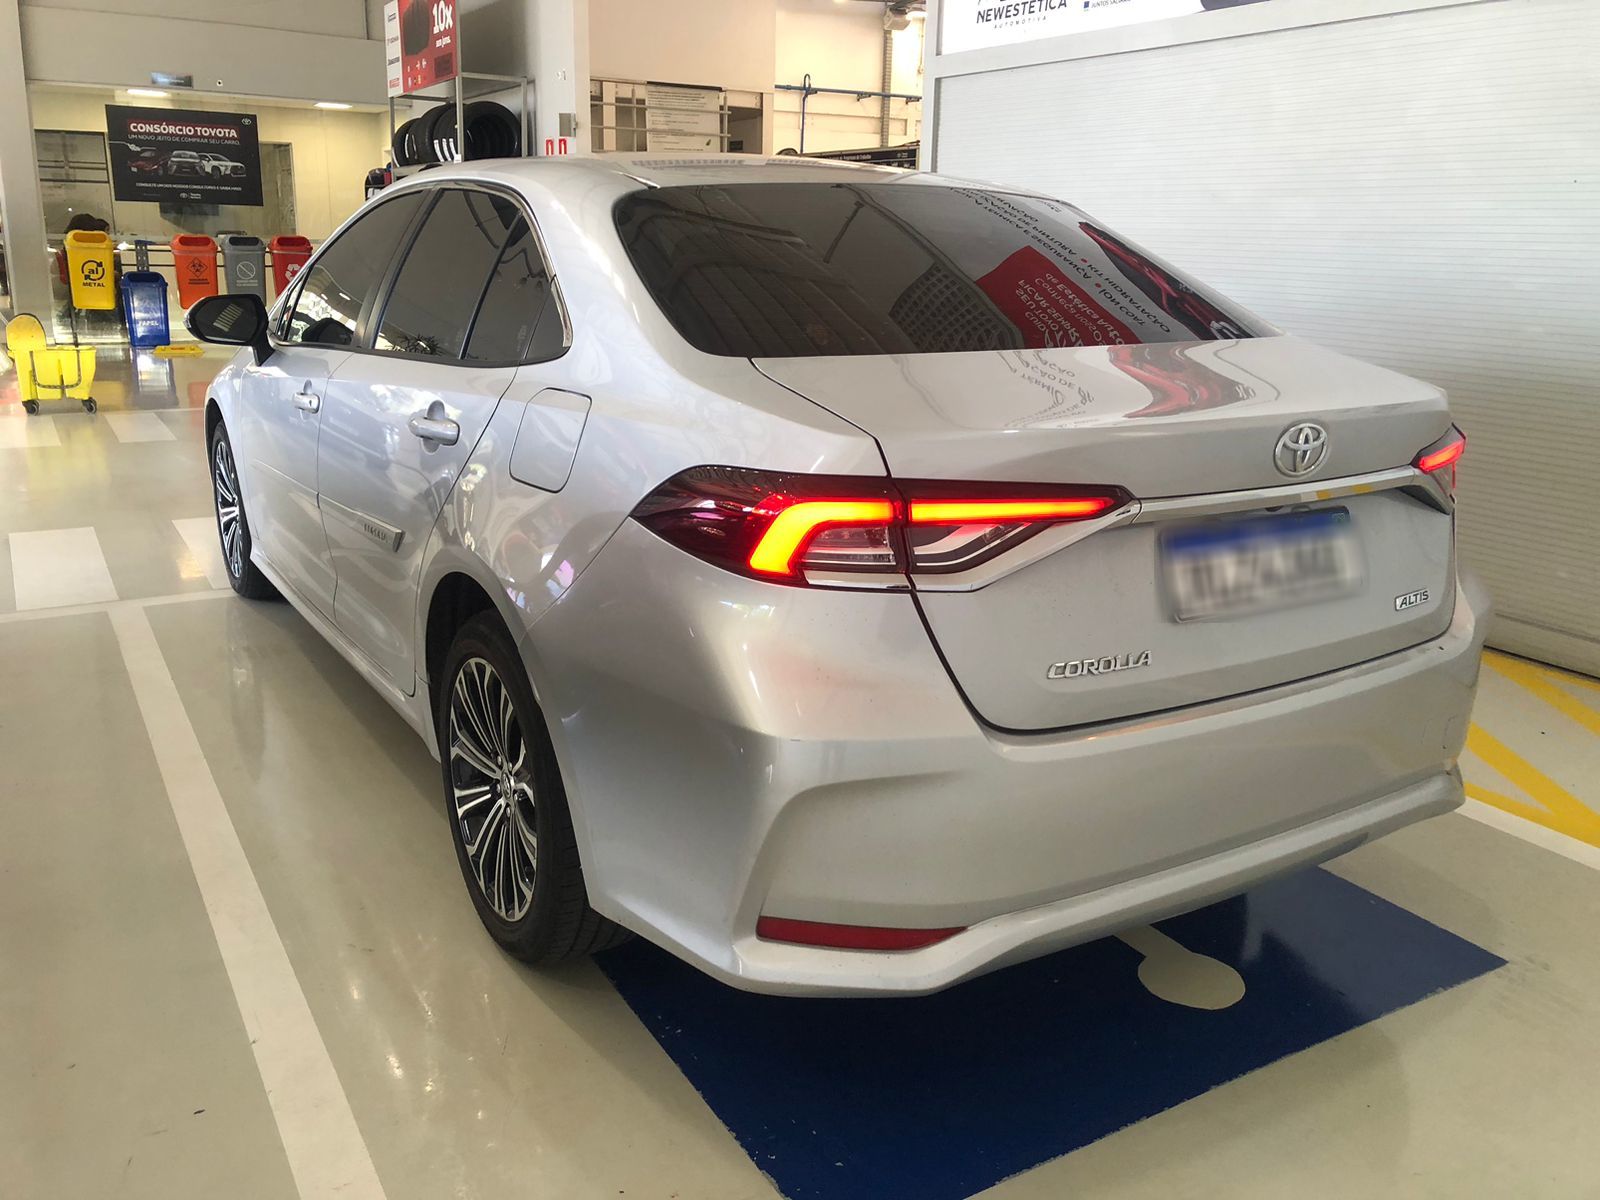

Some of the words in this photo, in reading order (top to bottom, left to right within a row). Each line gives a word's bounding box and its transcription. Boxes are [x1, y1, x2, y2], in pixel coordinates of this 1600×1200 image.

[432, 0, 453, 34] 10x
[993, 15, 1047, 29] AUTOMOTIVA
[130, 122, 195, 135] CONSÓRCIO
[195, 127, 238, 138] TOYOTA
[1399, 589, 1430, 609] ALTIS
[1047, 650, 1152, 680] COROLLA
